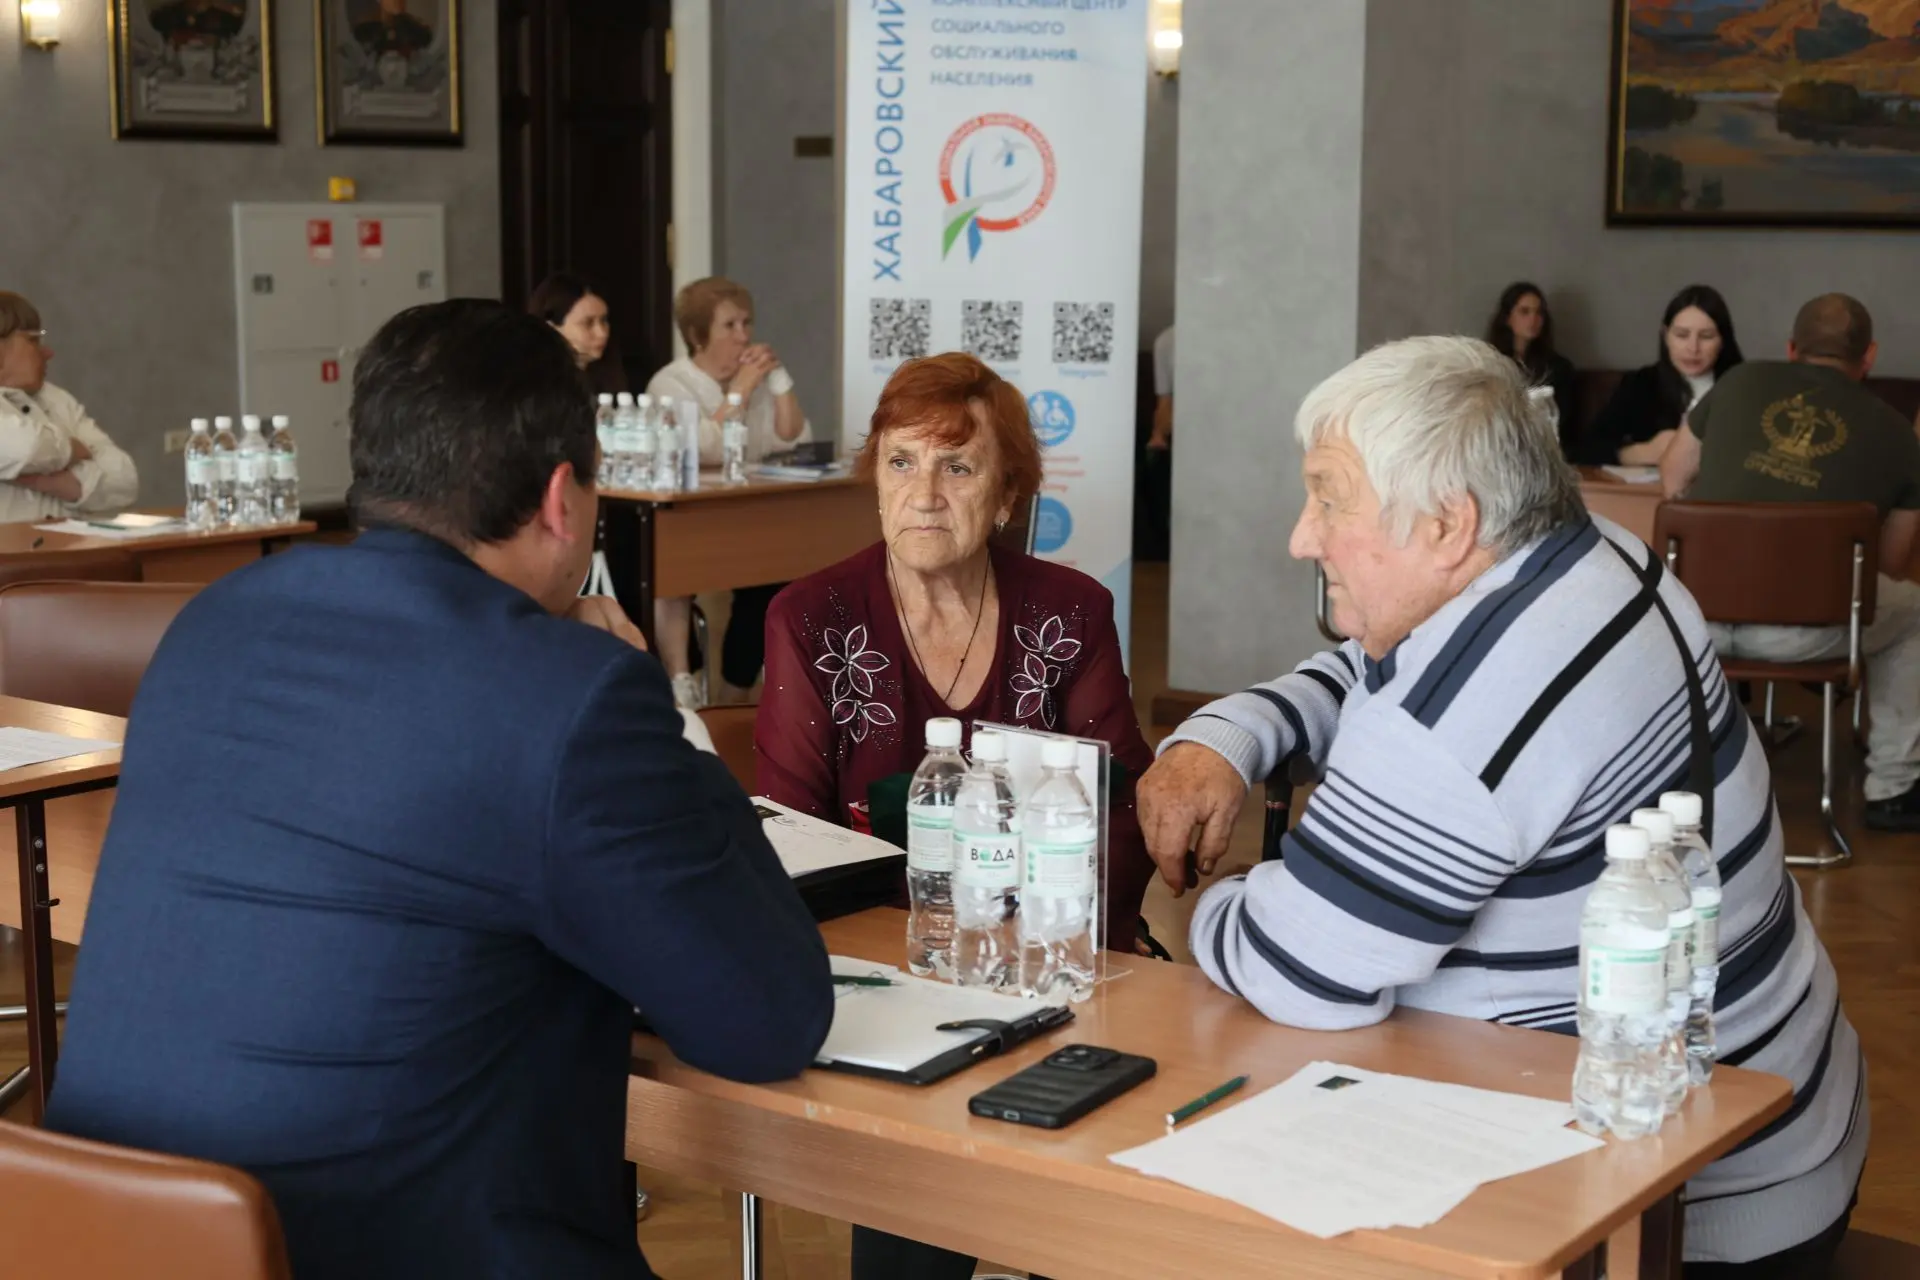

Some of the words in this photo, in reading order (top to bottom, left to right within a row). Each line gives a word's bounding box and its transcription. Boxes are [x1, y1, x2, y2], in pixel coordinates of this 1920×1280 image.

[931, 18, 1066, 36] СОЦИАЛЬНОГО
[930, 45, 1078, 61] ОБСЛУЖИВАНИЯ
[930, 72, 1034, 87] НАСЕЛЕНИЯ
[870, 0, 905, 282] ХАБАРОВСКИЙ
